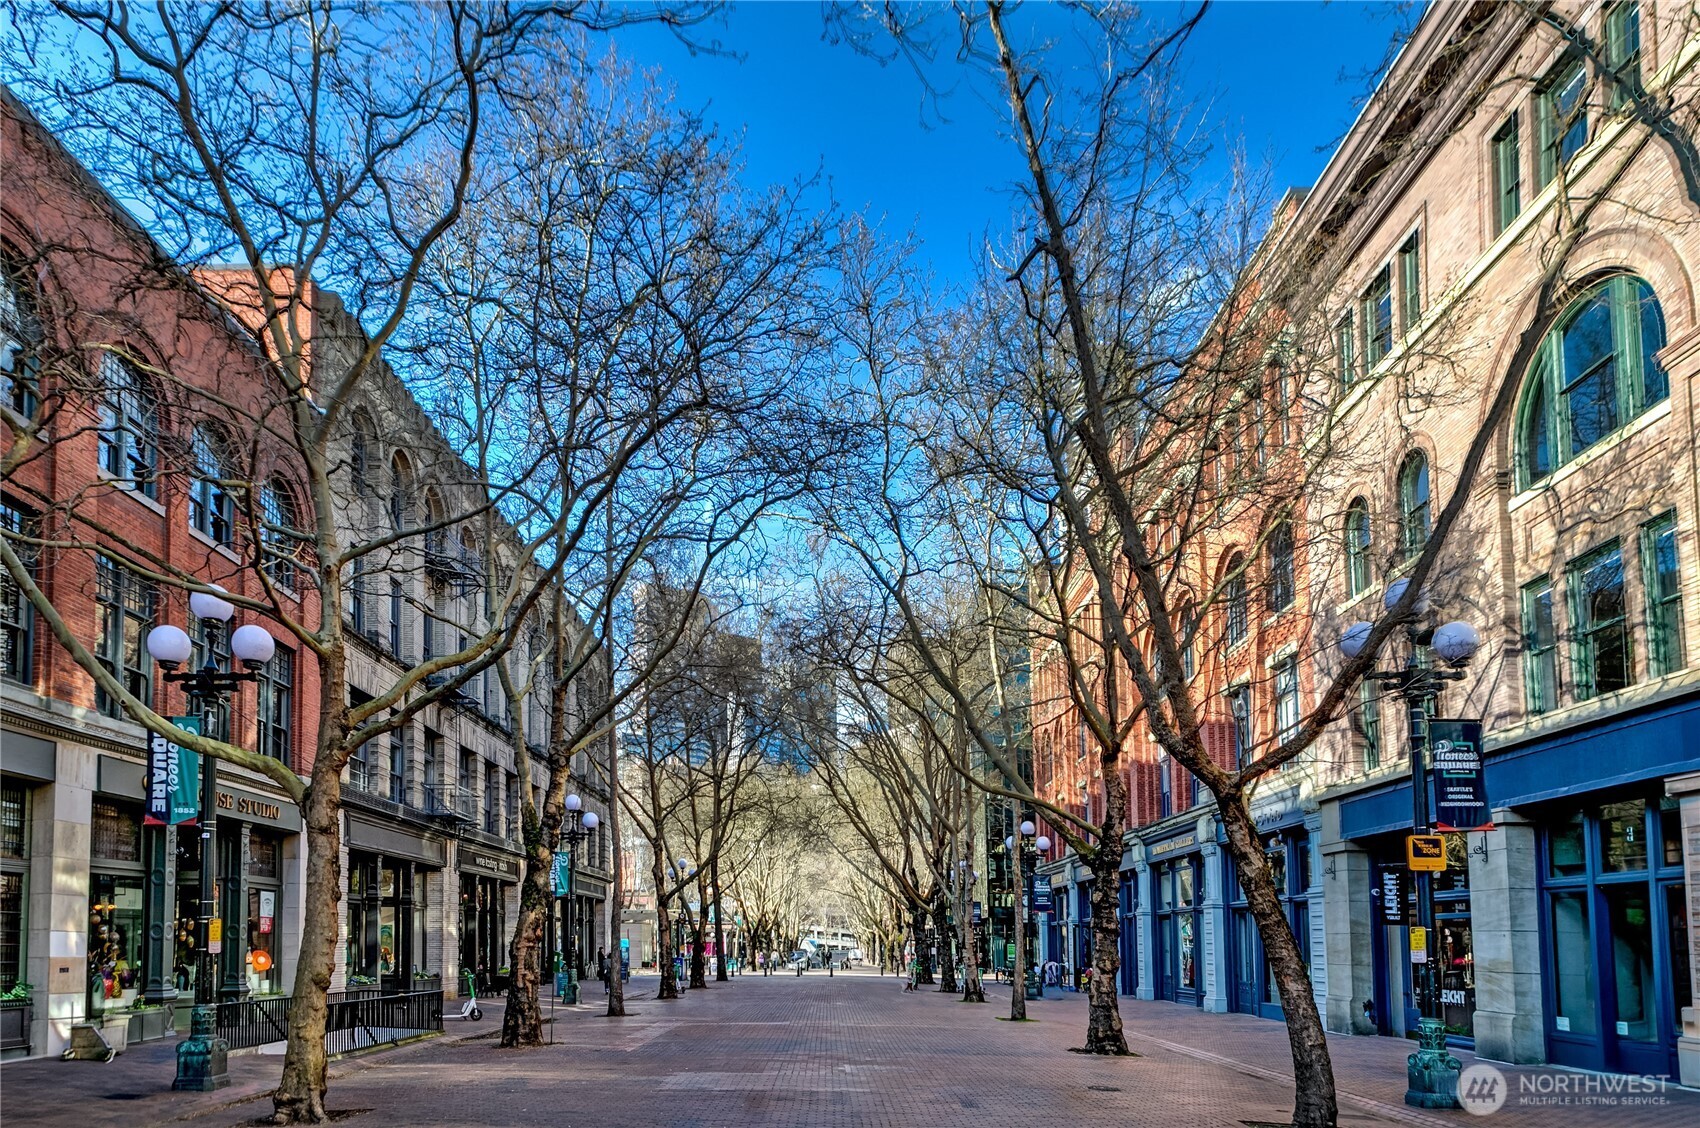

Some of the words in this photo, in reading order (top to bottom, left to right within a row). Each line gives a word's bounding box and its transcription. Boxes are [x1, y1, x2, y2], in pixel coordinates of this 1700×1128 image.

[1433, 739, 1480, 760] Pioneer
[151, 731, 167, 812] QUARE
[1433, 761, 1481, 770] SQUARE
[238, 797, 280, 820] STUDIO
[1422, 847, 1441, 855] ZONE
[1383, 872, 1398, 914] LEICHT
